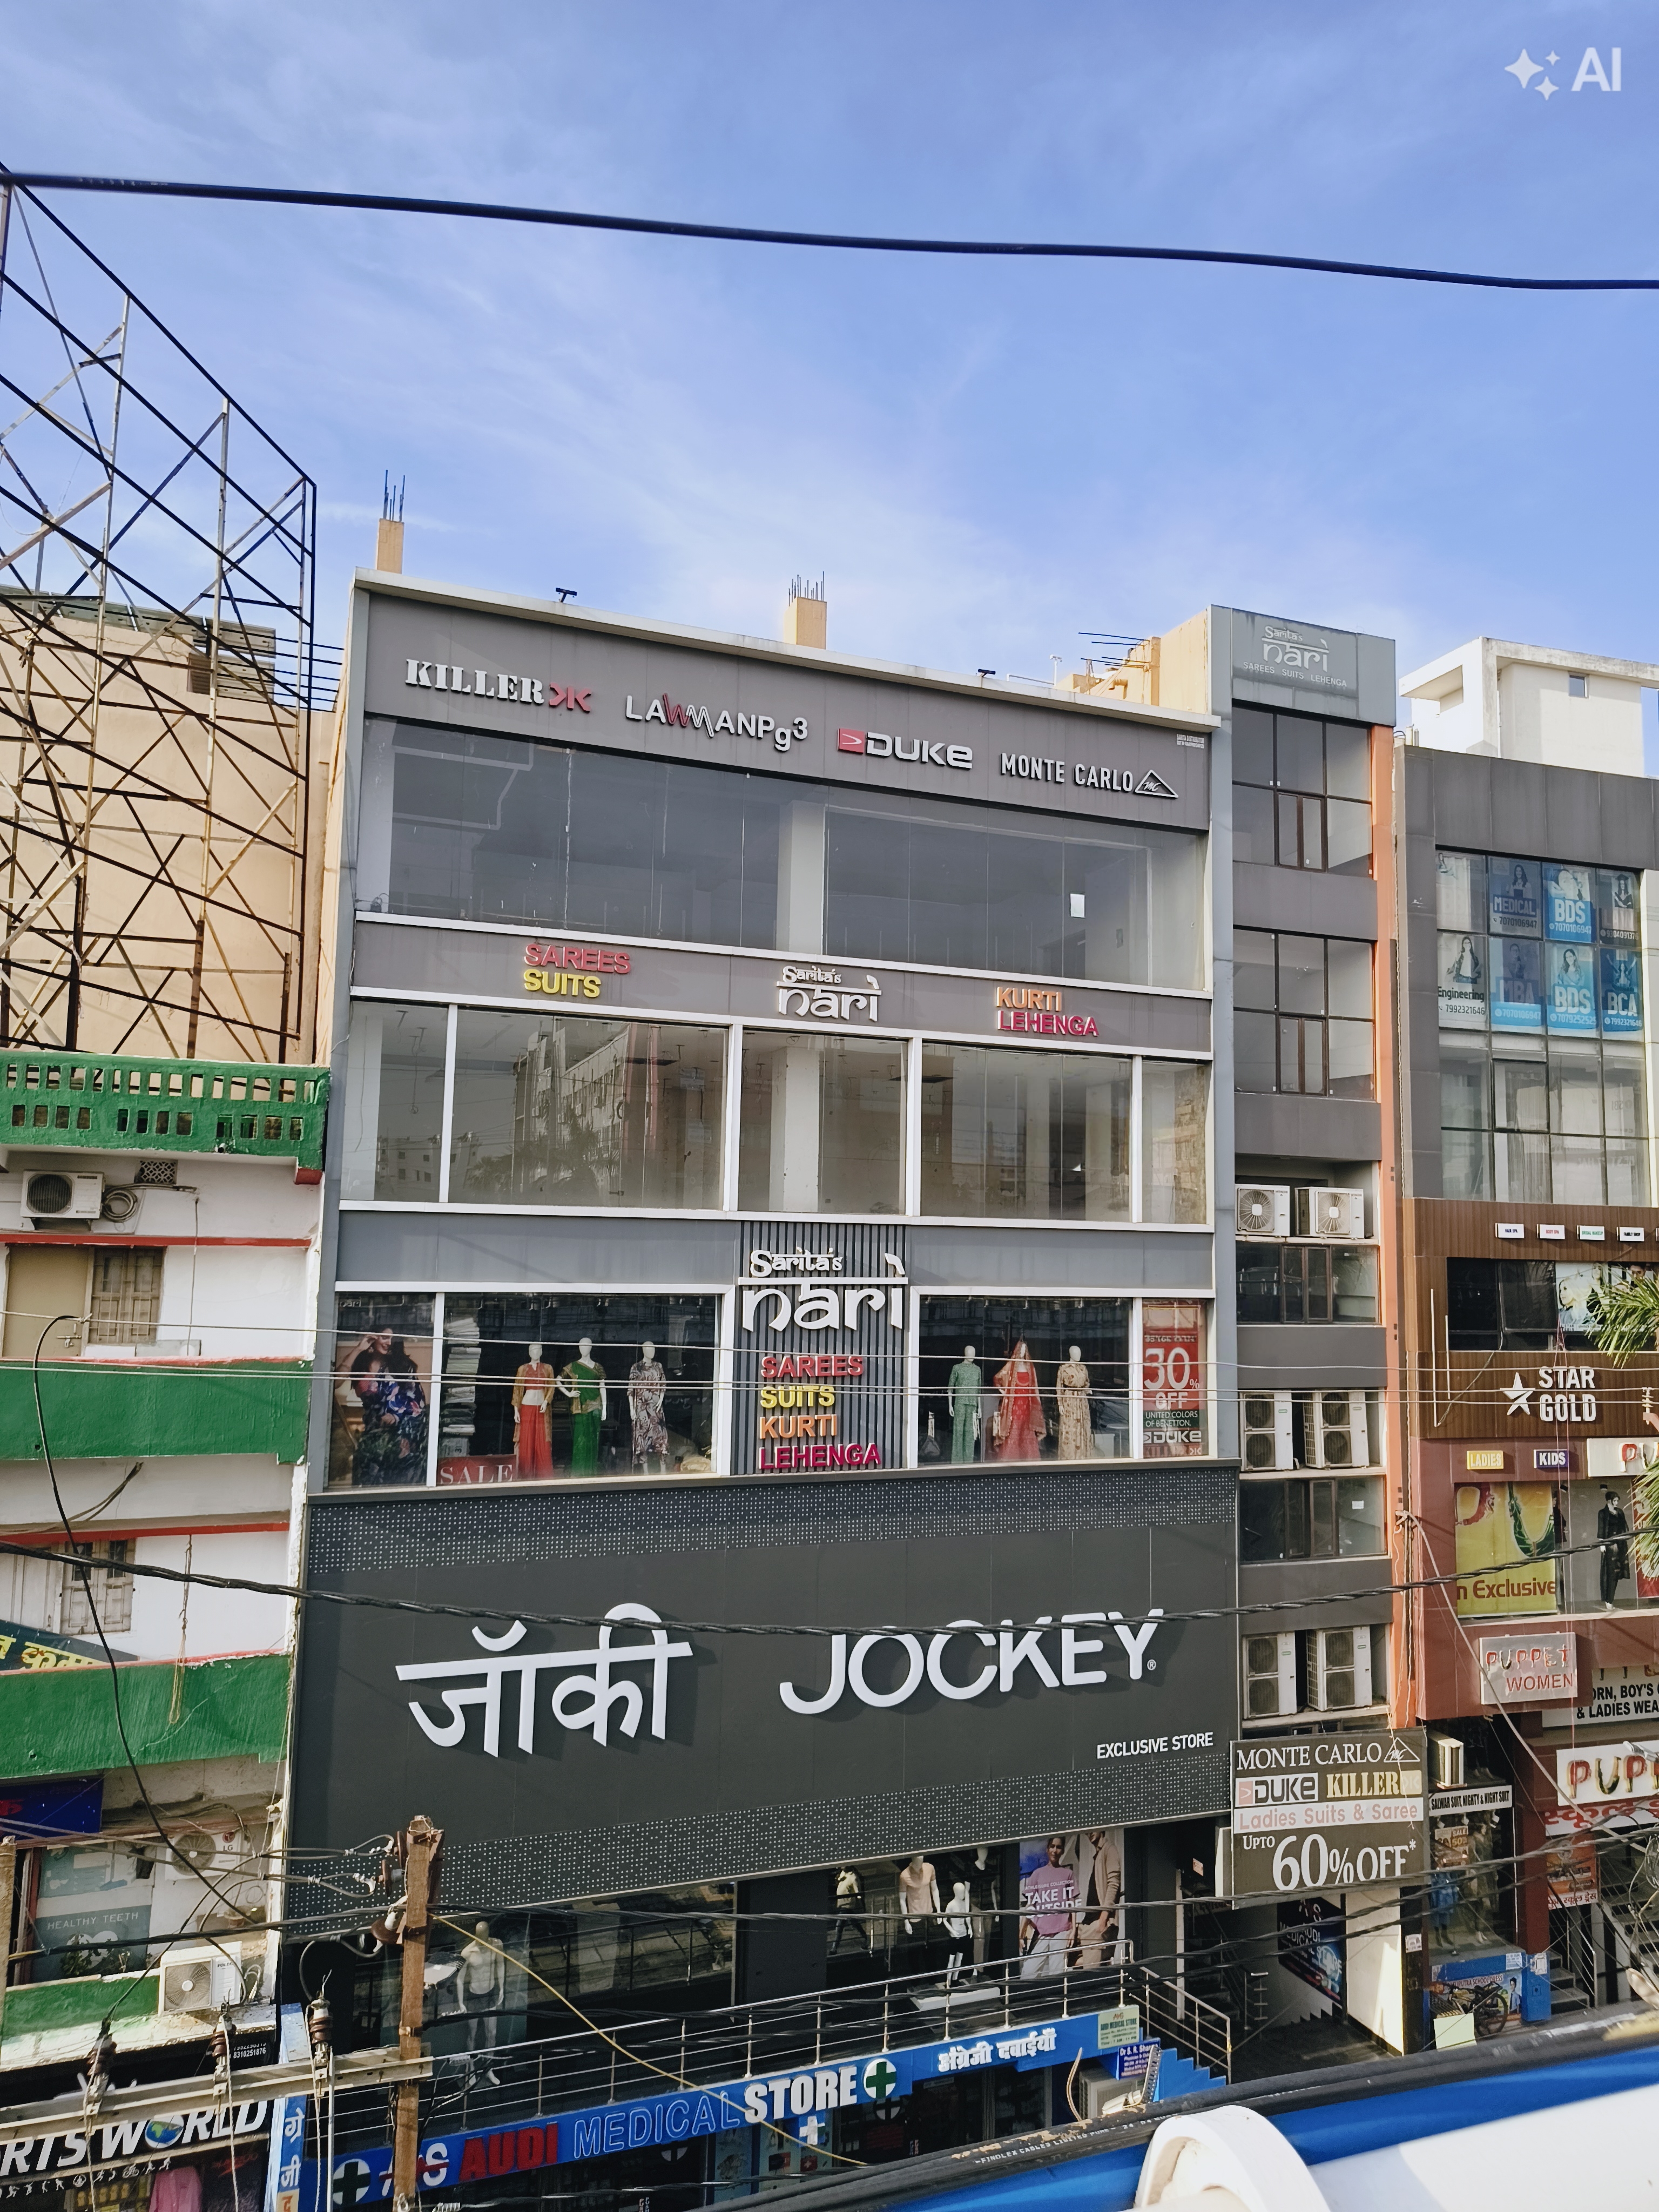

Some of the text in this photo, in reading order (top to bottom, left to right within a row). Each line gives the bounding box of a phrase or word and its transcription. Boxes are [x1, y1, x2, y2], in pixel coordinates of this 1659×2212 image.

[406, 659, 544, 705] KILLER
[1243, 662, 1347, 687] SAREES SUITS LEHENGA
[1001, 753, 1134, 793] MONTE CARLO
[1494, 896, 1536, 916] MEDICAL
[1555, 899, 1586, 923] BDS
[1499, 916, 1537, 929] 7070106947
[1555, 923, 1591, 934] 7070106947
[525, 943, 631, 974] SAREES
[524, 969, 601, 998] SUITS
[1438, 986, 1485, 1003] Engineering
[1500, 979, 1535, 1006] MBA
[996, 987, 1062, 1013] KURTI
[1446, 1004, 1485, 1015] 7992321646
[1555, 986, 1591, 1014] BDS
[1607, 992, 1638, 1017] BCA
[997, 1010, 1099, 1037] LEHENGA
[761, 1355, 864, 1378] SAREES
[1539, 1366, 1595, 1388] STAR
[760, 1385, 835, 1408] SUITS
[1155, 1392, 1188, 1410] OFF
[1539, 1393, 1596, 1422] GOLD
[759, 1414, 837, 1439] KURTI
[758, 1442, 881, 1470] LEHENGA
[1469, 1452, 1502, 1467] LADIES
[1539, 1452, 1566, 1466] KIDS
[440, 1464, 513, 1485] SALE
[1485, 1644, 1572, 1671] PUPPET
[395, 1603, 693, 1758] जॉकी
[1506, 1673, 1574, 1692] WOMEN
[1620, 1683, 1654, 1698] BOY'S
[1576, 1707, 1585, 1719] &
[1589, 1702, 1630, 1718] LADIES
[1097, 1732, 1214, 1759] EXCLUSIVE STORE
[1237, 1743, 1382, 1770] MONTE CARLO
[1326, 1771, 1400, 1798] KILLER
[1431, 1797, 1451, 1810] SALWAR
[1463, 1793, 1480, 1806] NIGHTY
[1485, 1791, 1498, 1804] NIGHT
[1499, 1790, 1509, 1803] SUIT
[1240, 1803, 1418, 1830] Ladies Suits & Saree
[1026, 1886, 1074, 1906] TAKE IT
[47, 1912, 139, 1930] HEALTHY TEETH
[1472, 1976, 1489, 1986] SCHOOL
[1489, 1974, 1503, 1983] DRESS
[233, 2047, 266, 2059] 8310251876
[1120, 2048, 1126, 2056] Dr
[459, 2122, 558, 2182] AUDI
[574, 2092, 740, 2159] MEDICAL
[744, 2066, 858, 2125] STORE
[1019, 2142, 1051, 2154] CABLES
